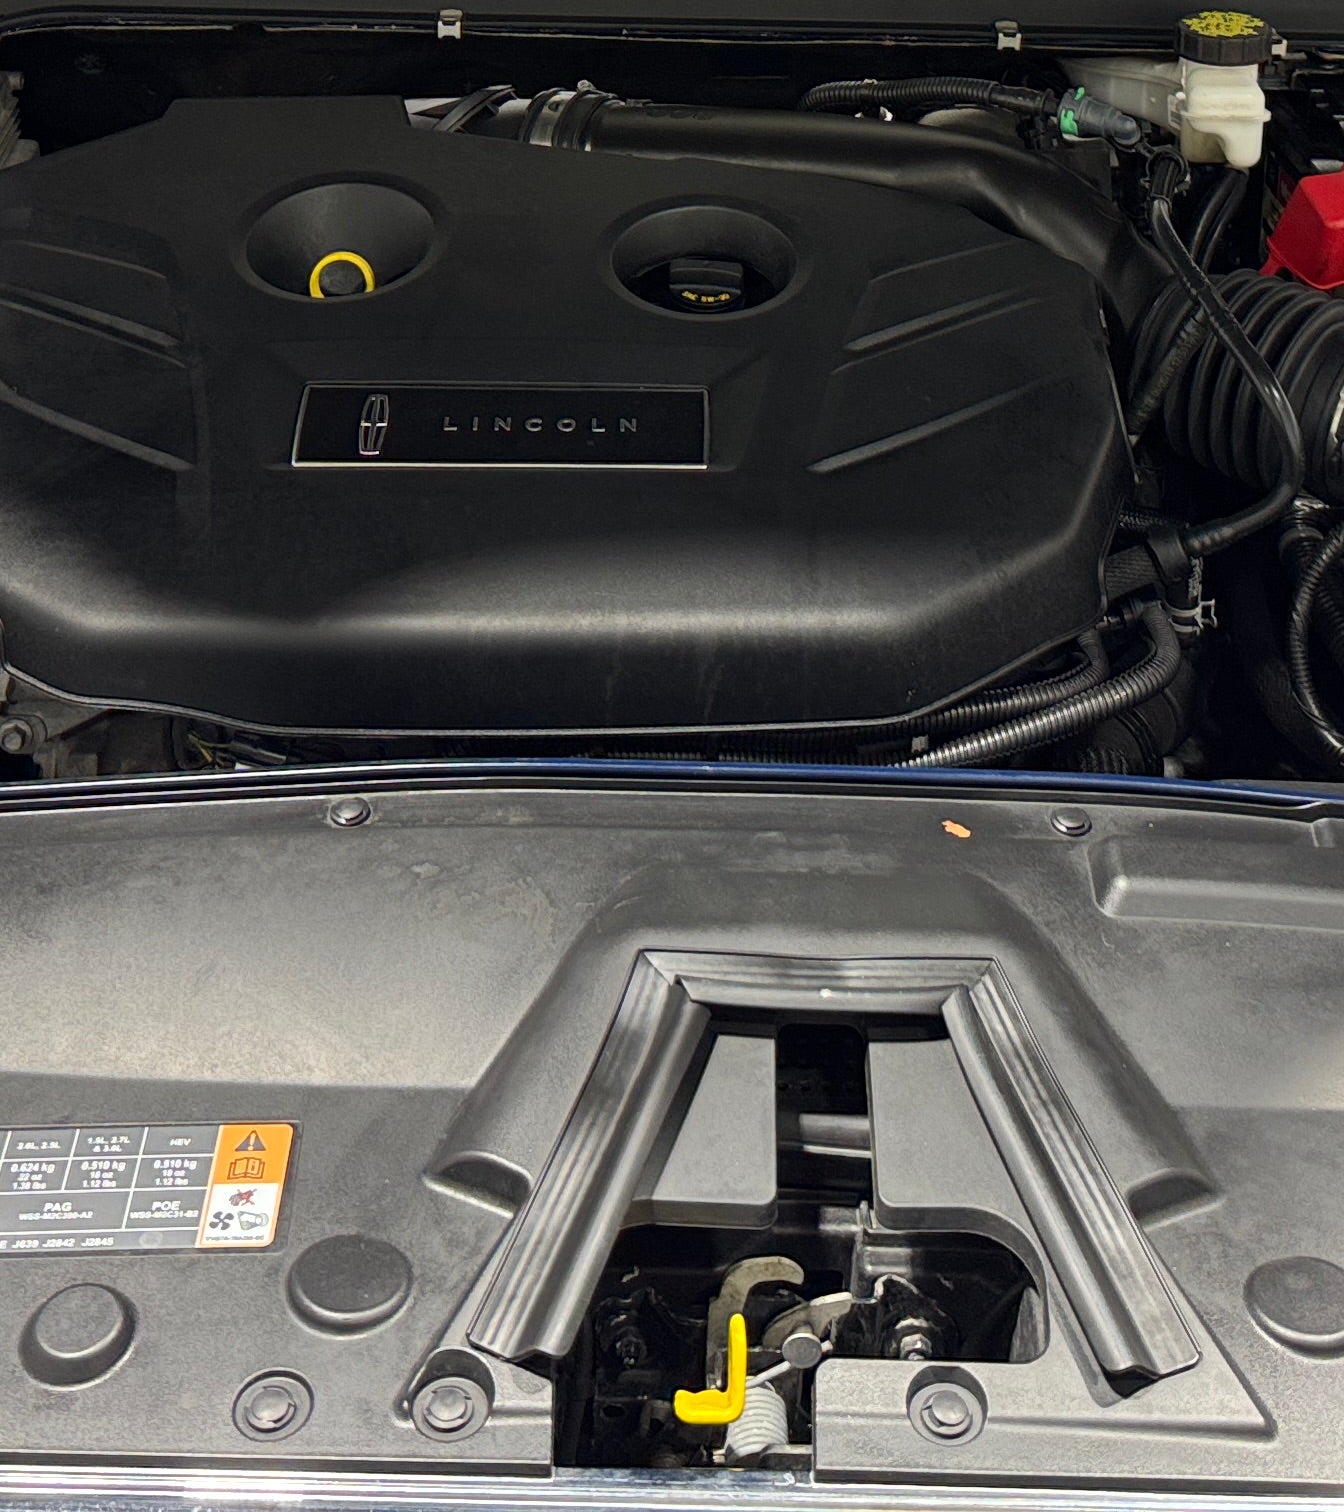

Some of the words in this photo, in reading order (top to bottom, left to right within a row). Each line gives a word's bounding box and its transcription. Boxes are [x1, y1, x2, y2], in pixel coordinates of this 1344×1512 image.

[443, 416, 639, 433] LINCOLN
[40, 1162, 56, 1174] kg
[111, 1160, 127, 1172] kg
[183, 1159, 198, 1170] kg
[43, 1202, 73, 1212] PAG
[151, 1200, 181, 1211] POE
